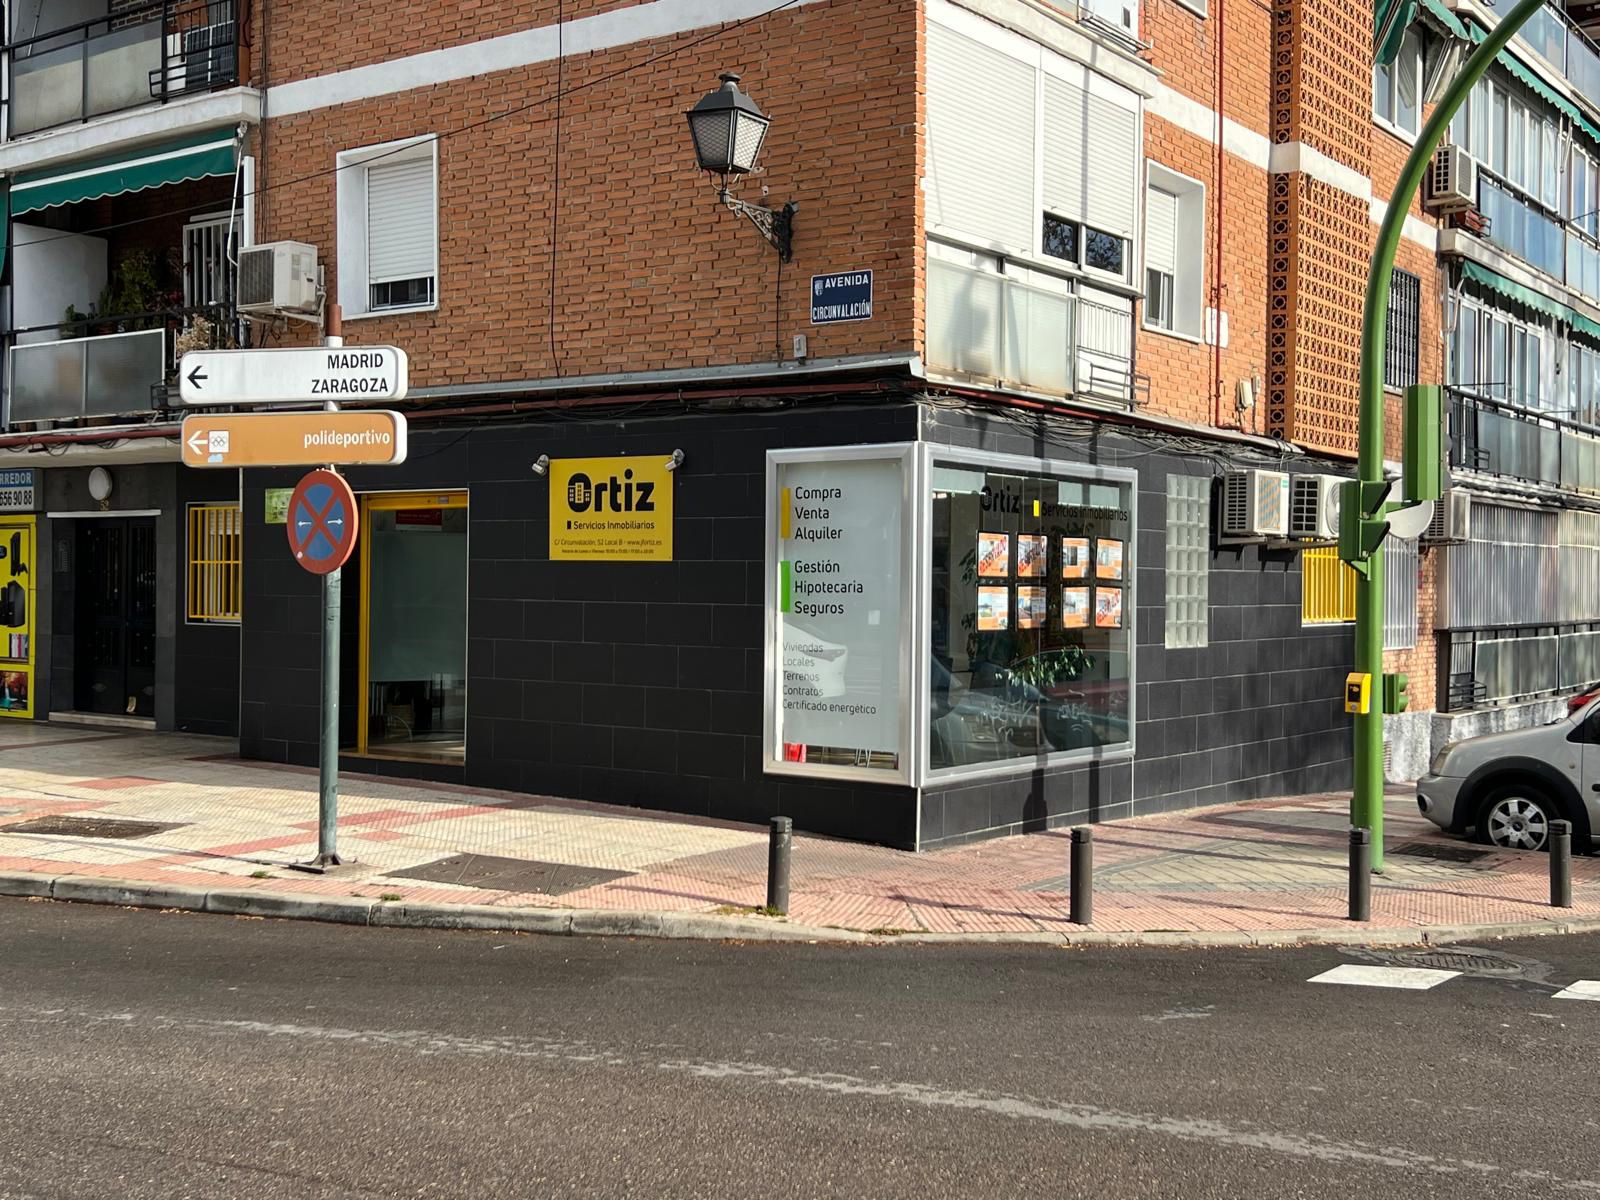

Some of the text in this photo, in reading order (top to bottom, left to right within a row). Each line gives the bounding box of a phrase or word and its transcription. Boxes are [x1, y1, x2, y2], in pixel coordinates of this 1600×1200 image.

[825, 274, 869, 288] AVENIDA
[813, 299, 870, 320] CIRCUNVALACIÓN
[328, 353, 384, 369] MADRID
[311, 377, 388, 393] ZARAGOZA
[304, 429, 390, 448] polideportivo
[568, 468, 655, 513] Ortiz
[795, 486, 842, 501] Compra
[980, 485, 1020, 514] Ortiz
[795, 506, 830, 519] Venta
[1042, 502, 1078, 518] Servicios
[574, 520, 655, 530] Servicios Inmobiliarios
[794, 526, 843, 542] Alquiler
[794, 559, 840, 573] Gestión
[794, 580, 863, 596] Hipotecaria
[794, 601, 844, 617] Seguros
[783, 642, 824, 653] Viviendas
[783, 657, 815, 667] Locales
[783, 670, 820, 681] Terrenos
[783, 685, 824, 697] Contratos
[783, 699, 877, 715] Certificado energético
